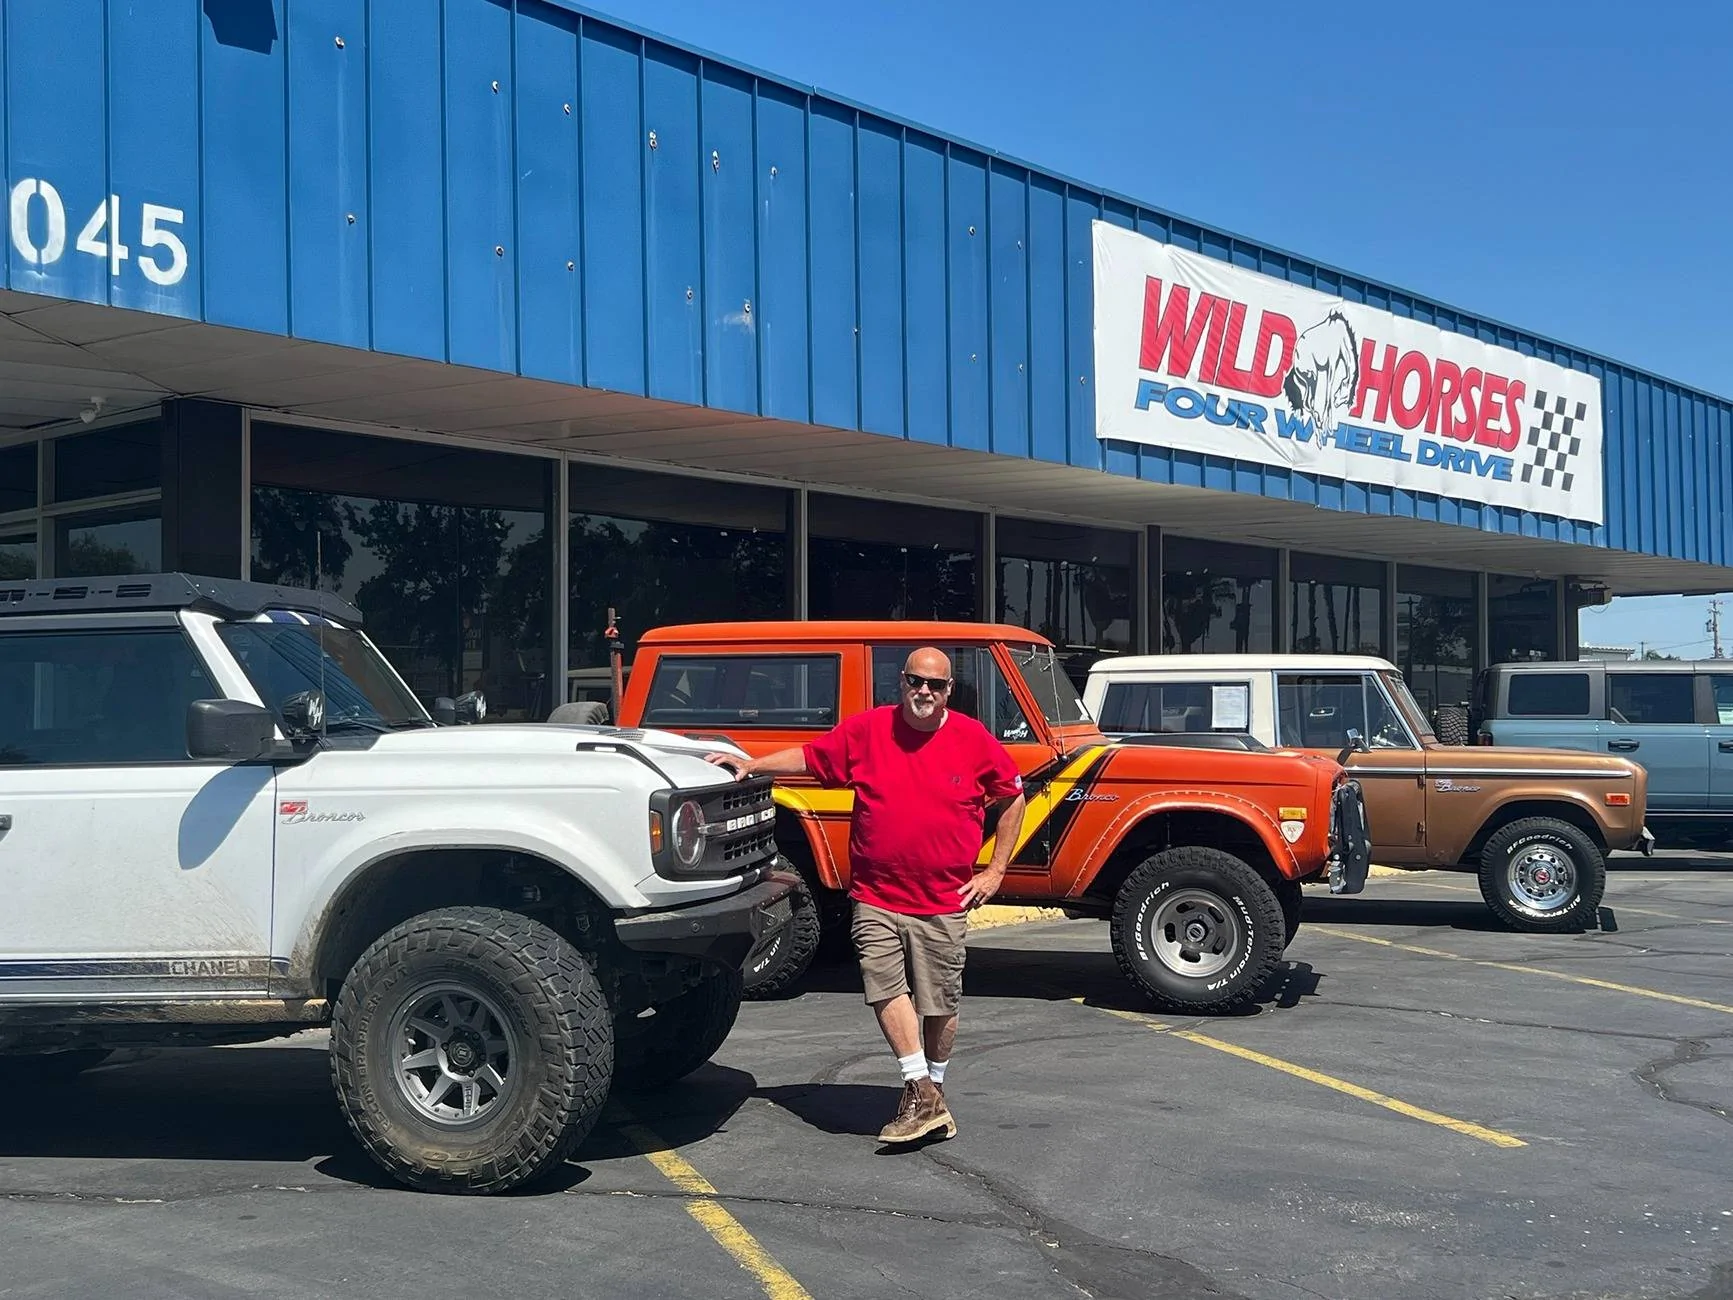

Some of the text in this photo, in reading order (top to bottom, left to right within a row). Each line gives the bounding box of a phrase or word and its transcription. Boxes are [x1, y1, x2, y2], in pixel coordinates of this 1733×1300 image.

[11, 178, 188, 286] 045
[1139, 275, 1527, 453] WILD HORSES
[1135, 379, 1515, 483] FOUR WHEEL DRIVE
[1065, 788, 1120, 802] Bronco
[1506, 834, 1574, 854] BFGoodrich
[1134, 881, 1170, 961] BFGoodrich
[1207, 895, 1255, 991] Mud-Terrain T/A
[169, 960, 248, 975] CHANEL
